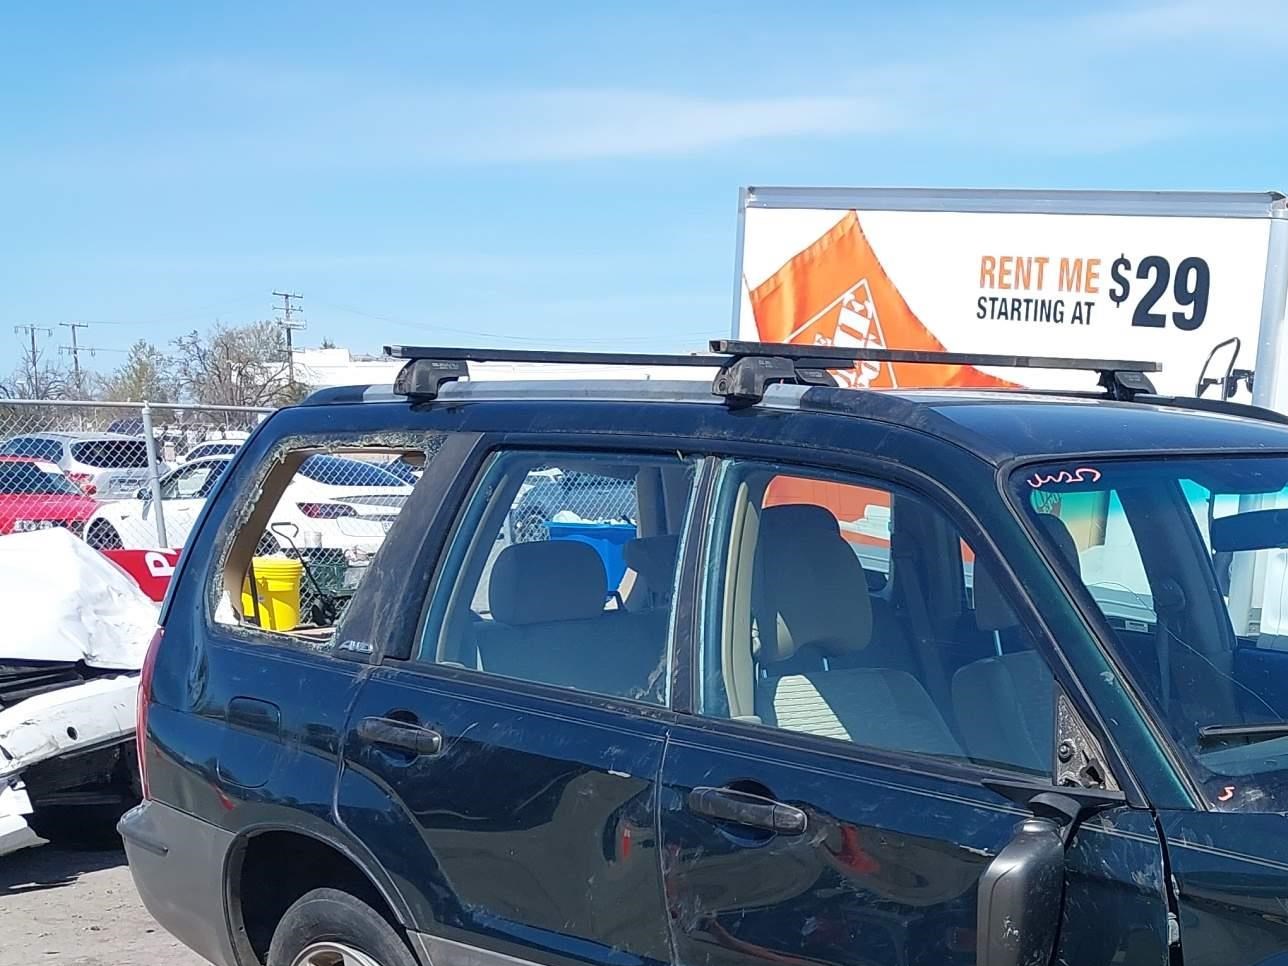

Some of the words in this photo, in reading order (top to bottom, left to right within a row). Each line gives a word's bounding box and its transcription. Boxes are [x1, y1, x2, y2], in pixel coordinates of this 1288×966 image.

[976, 296, 1065, 324] STARTING
[1070, 300, 1095, 325] AT
[979, 255, 1049, 291] RENT
[1058, 256, 1101, 294] ME
[1109, 253, 1210, 331] $29
